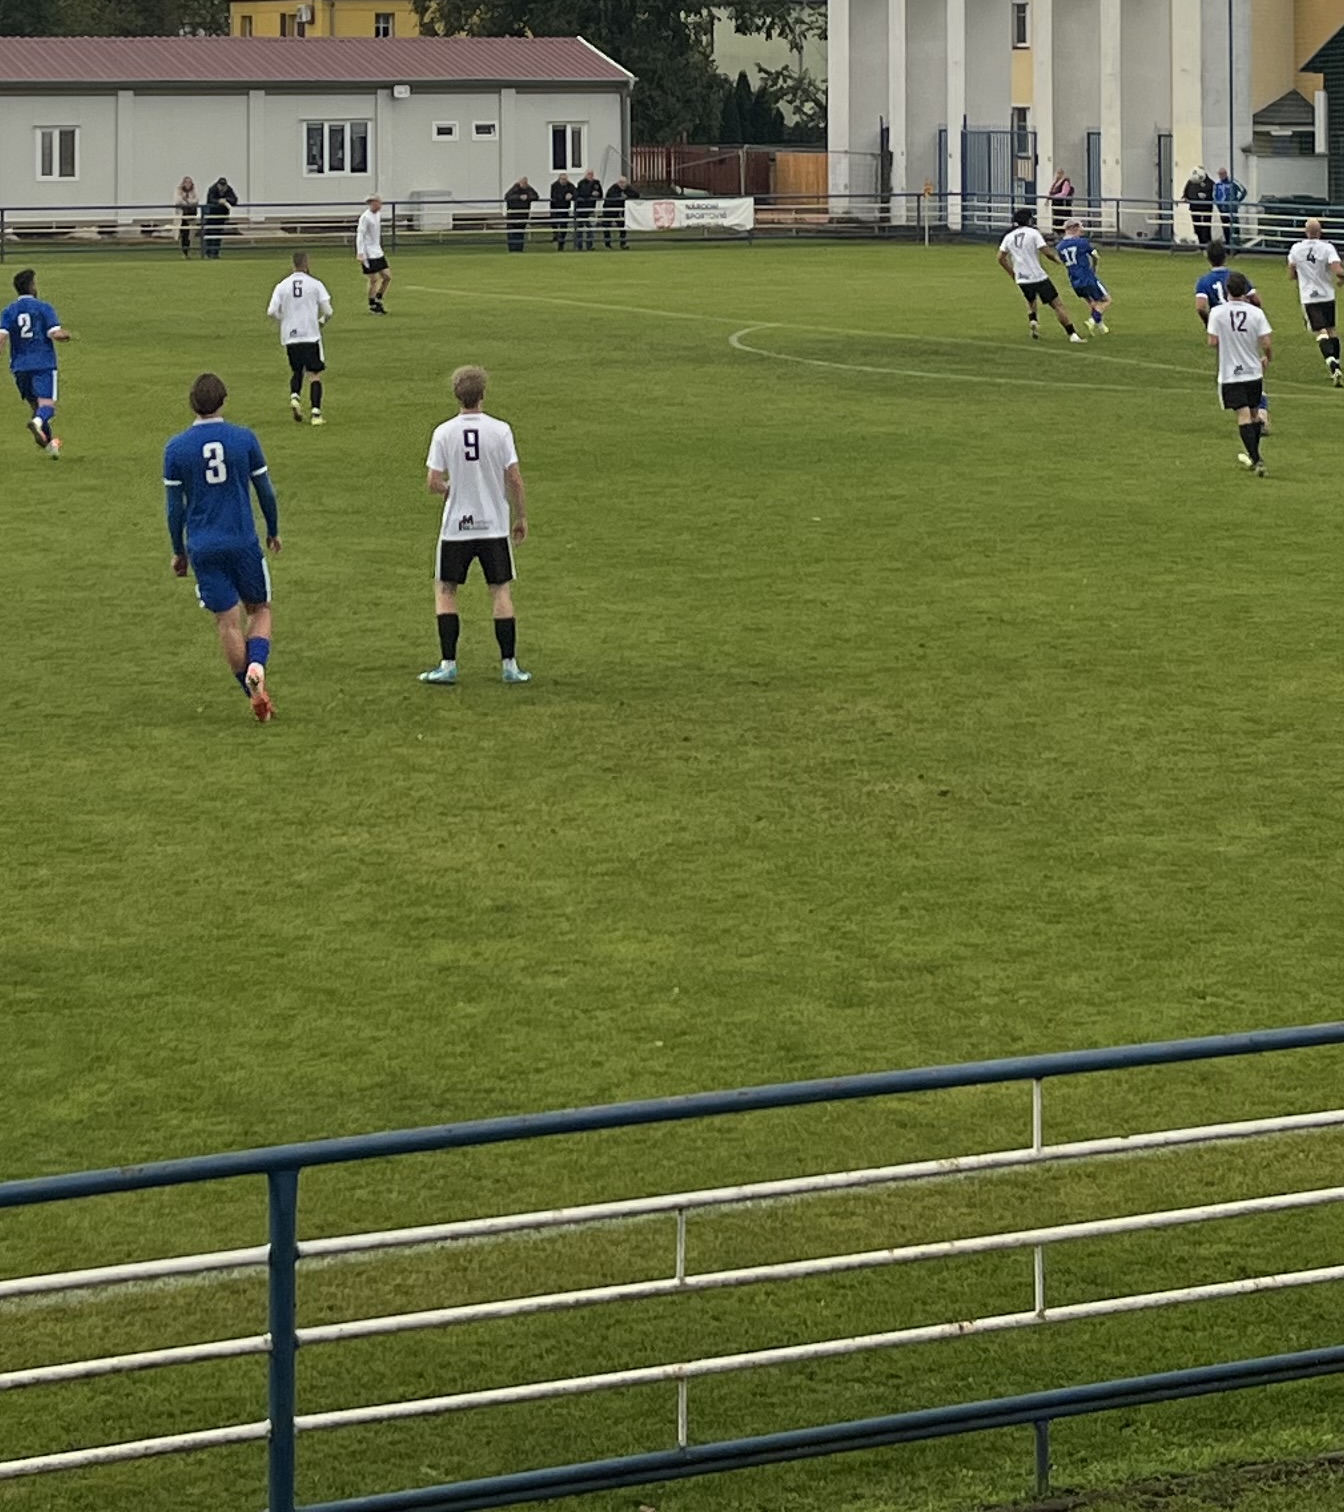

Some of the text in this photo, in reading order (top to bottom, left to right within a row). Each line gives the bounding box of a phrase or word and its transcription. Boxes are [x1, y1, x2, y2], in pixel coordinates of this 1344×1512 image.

[1061, 246, 1077, 267] 17
[1306, 247, 1316, 265] 4
[293, 280, 303, 298] 6
[17, 313, 33, 339] 2
[1229, 310, 1248, 333] 12
[463, 428, 479, 461] 9
[202, 441, 227, 484] 3
